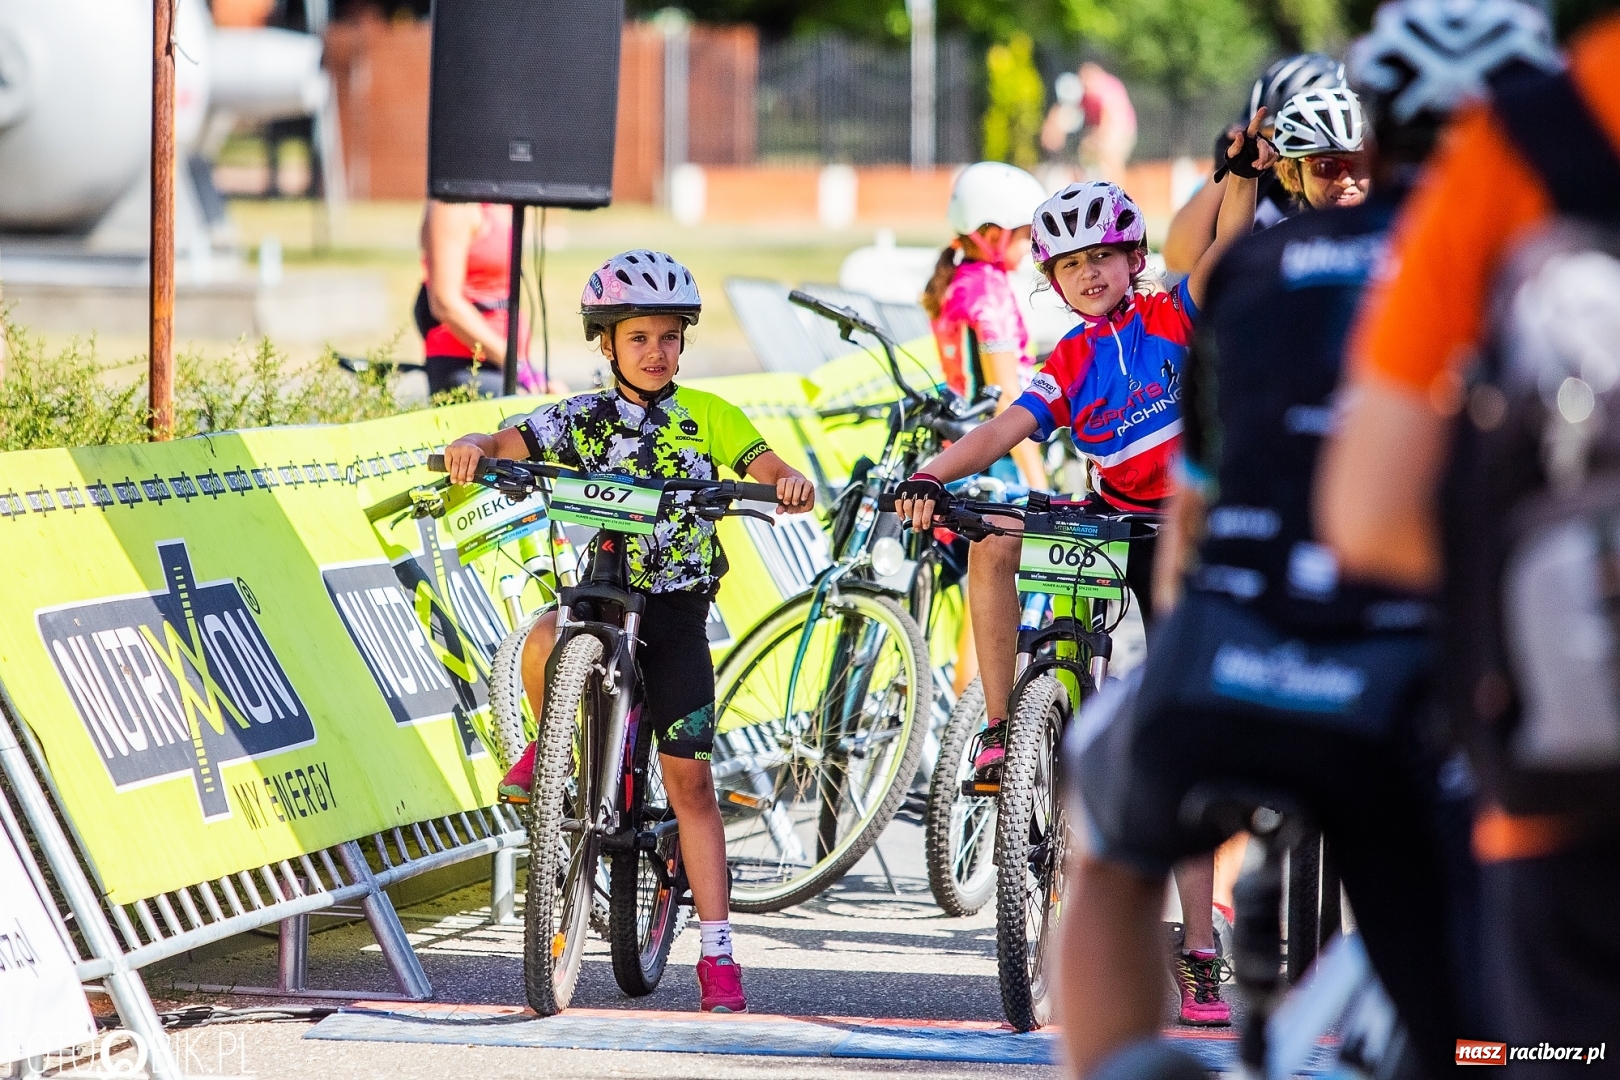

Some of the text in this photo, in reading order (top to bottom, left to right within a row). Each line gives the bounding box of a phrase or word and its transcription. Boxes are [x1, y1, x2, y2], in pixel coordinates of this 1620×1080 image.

[457, 490, 533, 531] OPIEKU
[584, 483, 633, 504] 067
[232, 761, 337, 830] MY ENERGY
